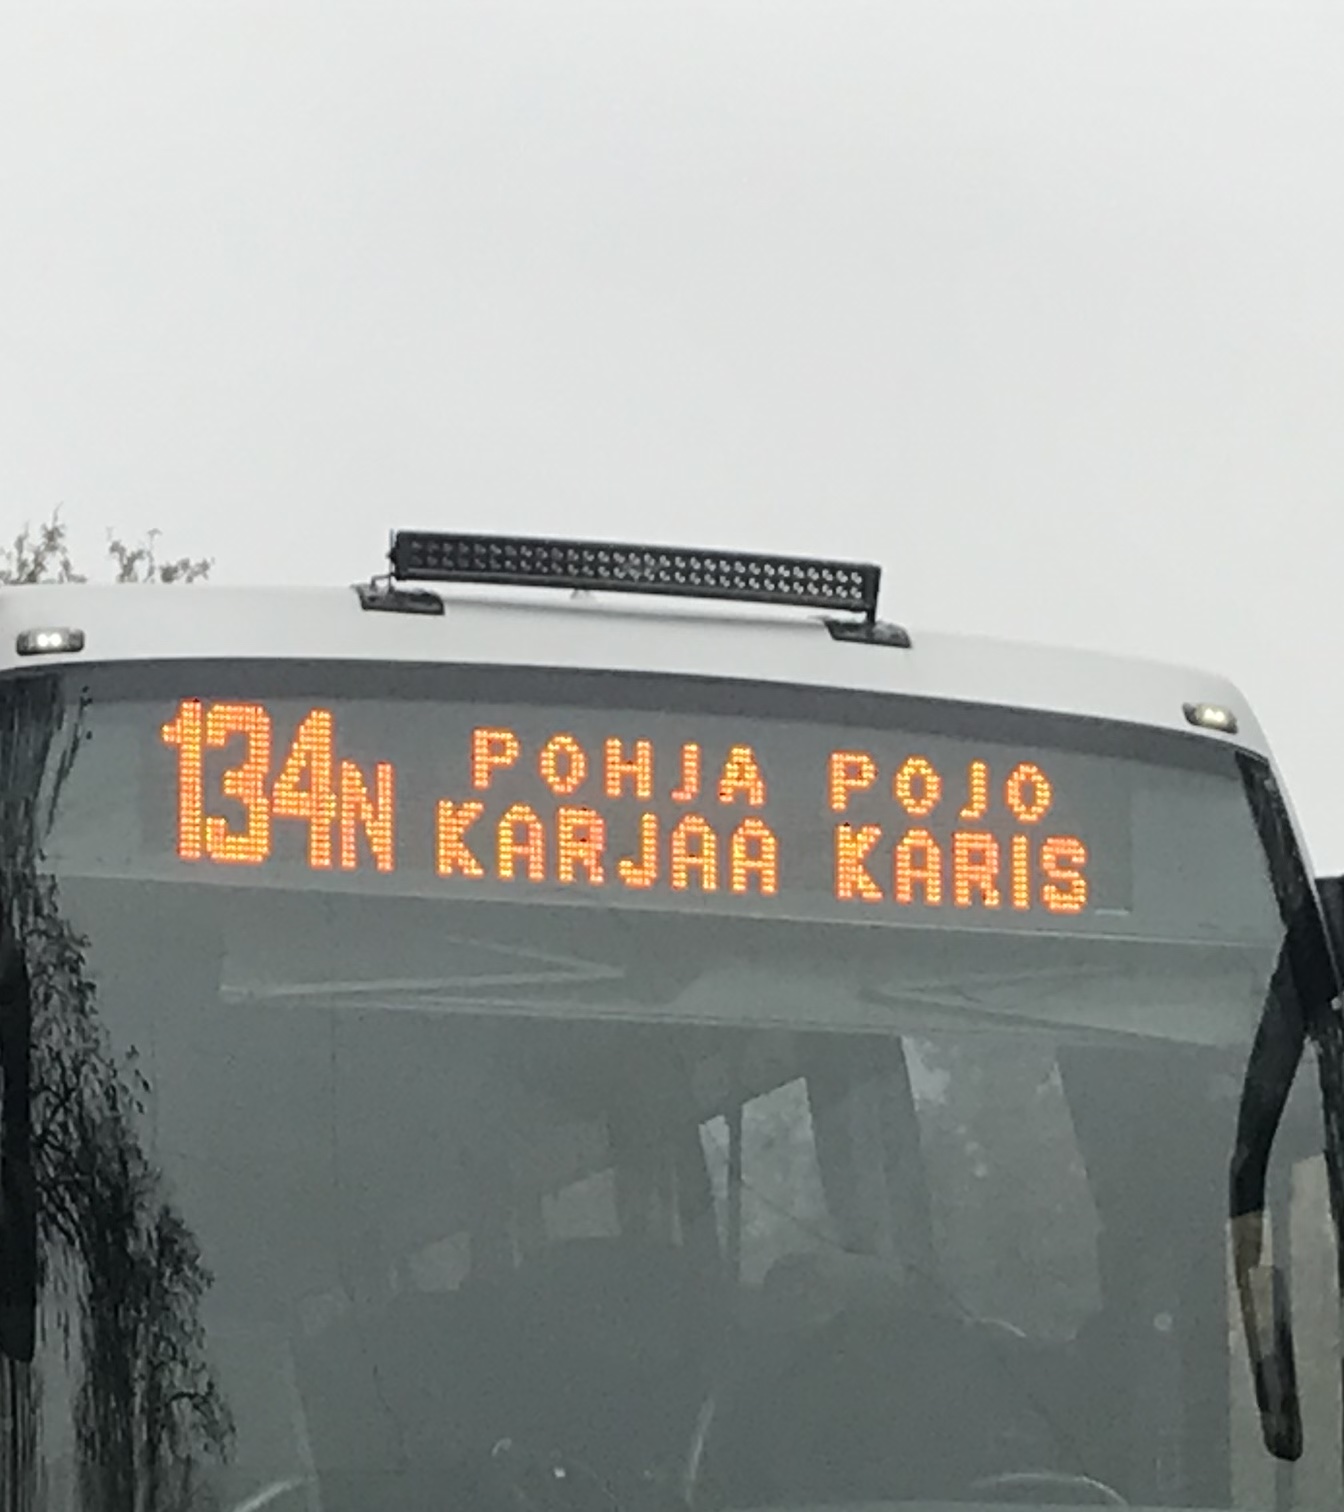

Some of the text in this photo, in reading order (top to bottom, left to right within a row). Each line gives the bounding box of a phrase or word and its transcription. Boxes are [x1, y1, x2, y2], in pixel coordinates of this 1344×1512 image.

[162, 697, 396, 874] 134N
[472, 725, 1055, 825] POHJA POJO
[435, 799, 1089, 916] KARJAA KARIS
